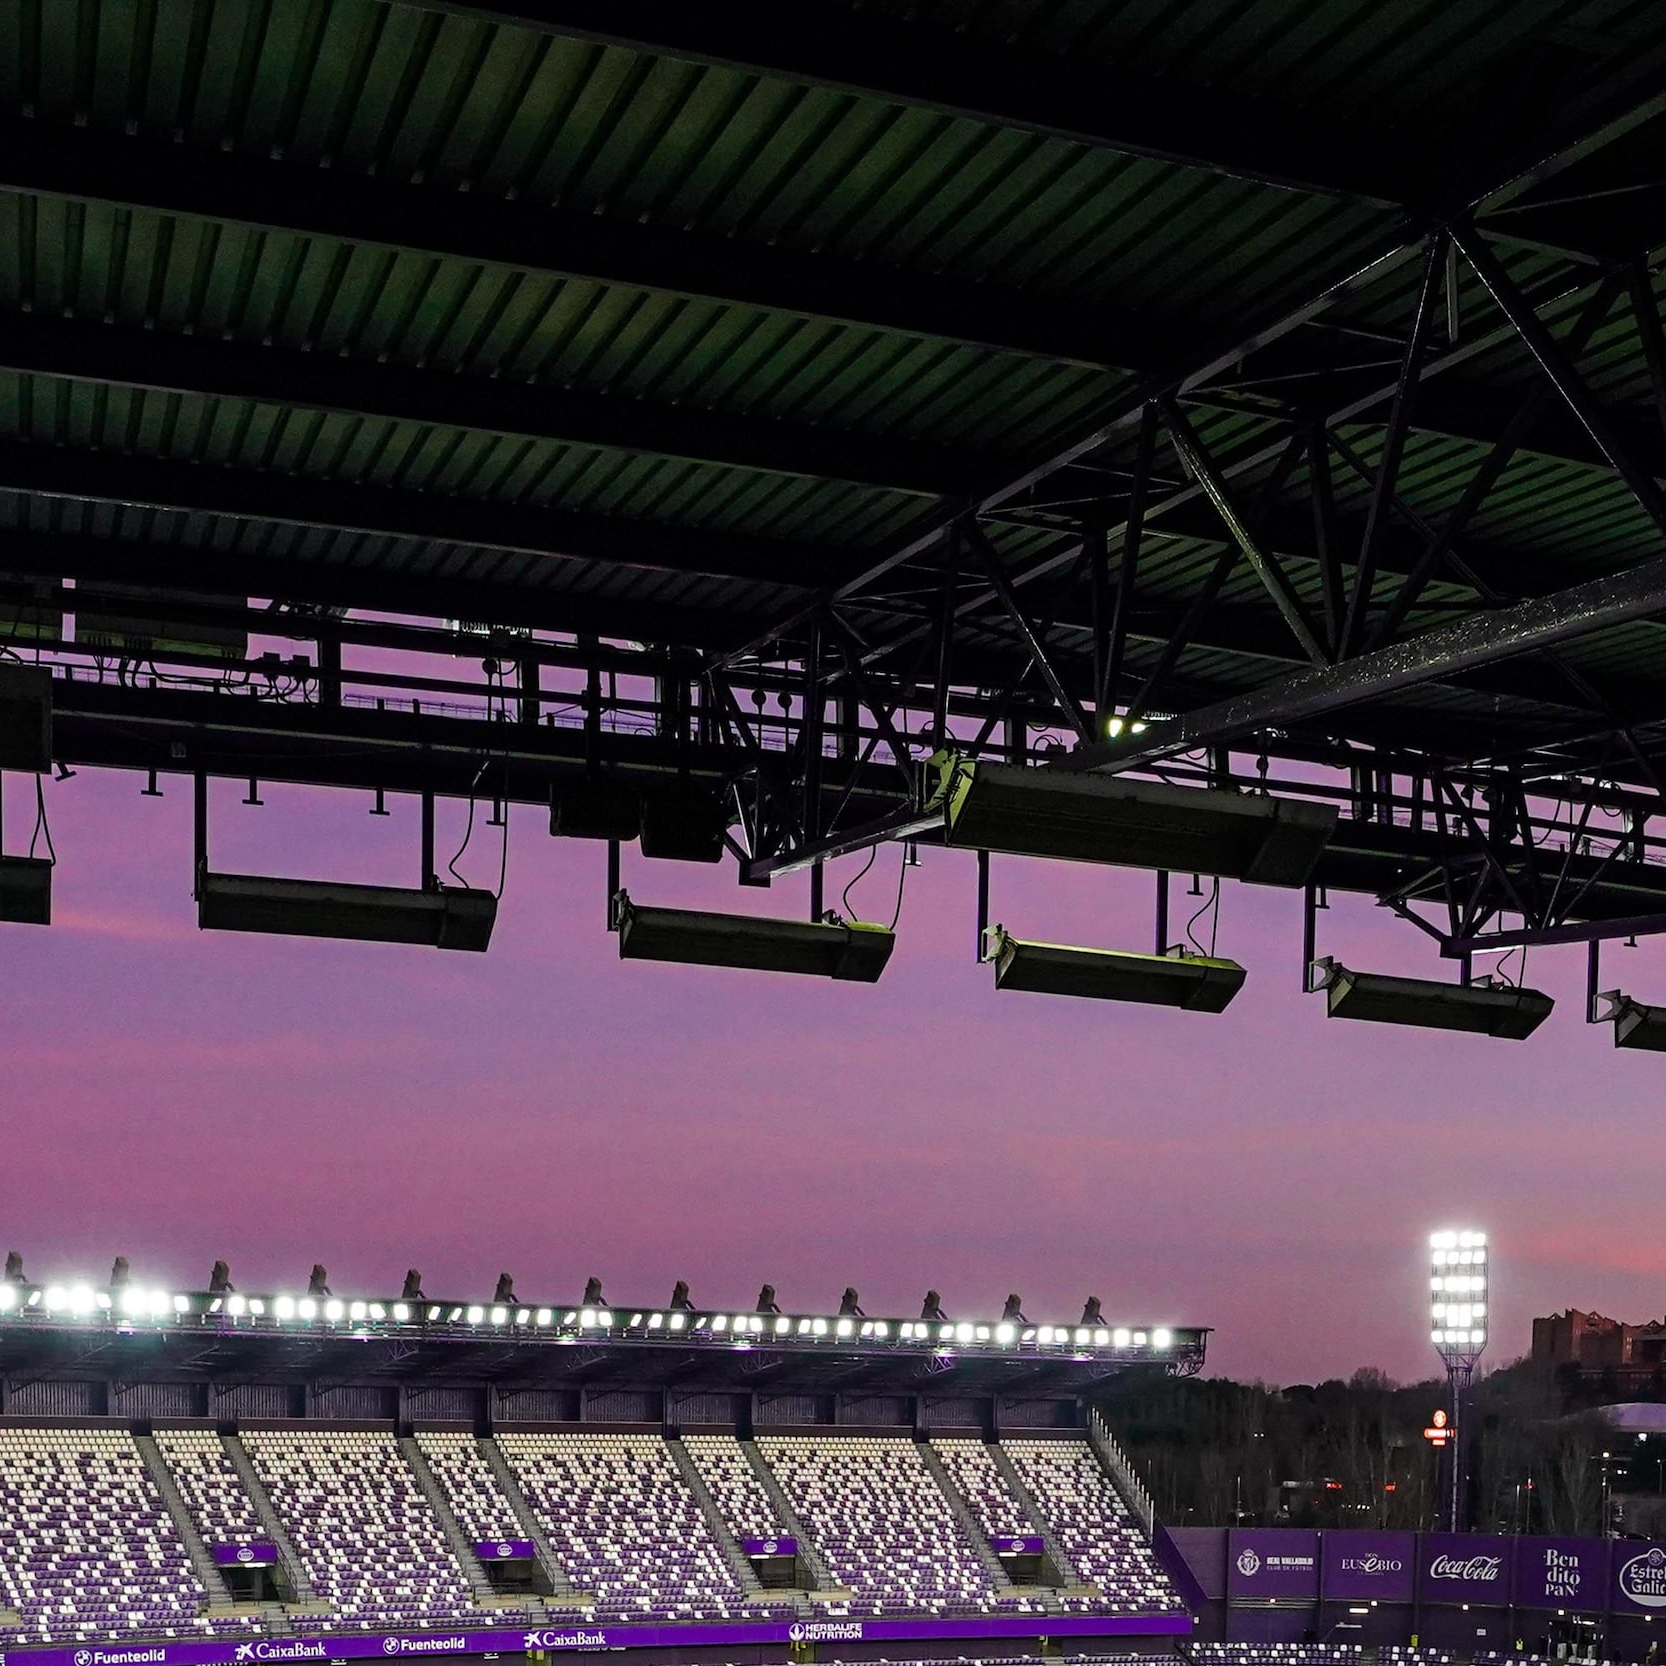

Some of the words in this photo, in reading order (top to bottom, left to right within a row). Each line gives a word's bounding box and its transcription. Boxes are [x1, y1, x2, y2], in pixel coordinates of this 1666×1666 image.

[1547, 1566, 1581, 1585] dito
[805, 1622, 863, 1634] HERBALIFE
[805, 1630, 863, 1641] NUTRITION
[401, 1637, 465, 1652] Fuenteolid
[543, 1630, 606, 1648] CaixaBank
[94, 1650, 165, 1664] Fuenteolid
[257, 1642, 326, 1660] CaixaBank
